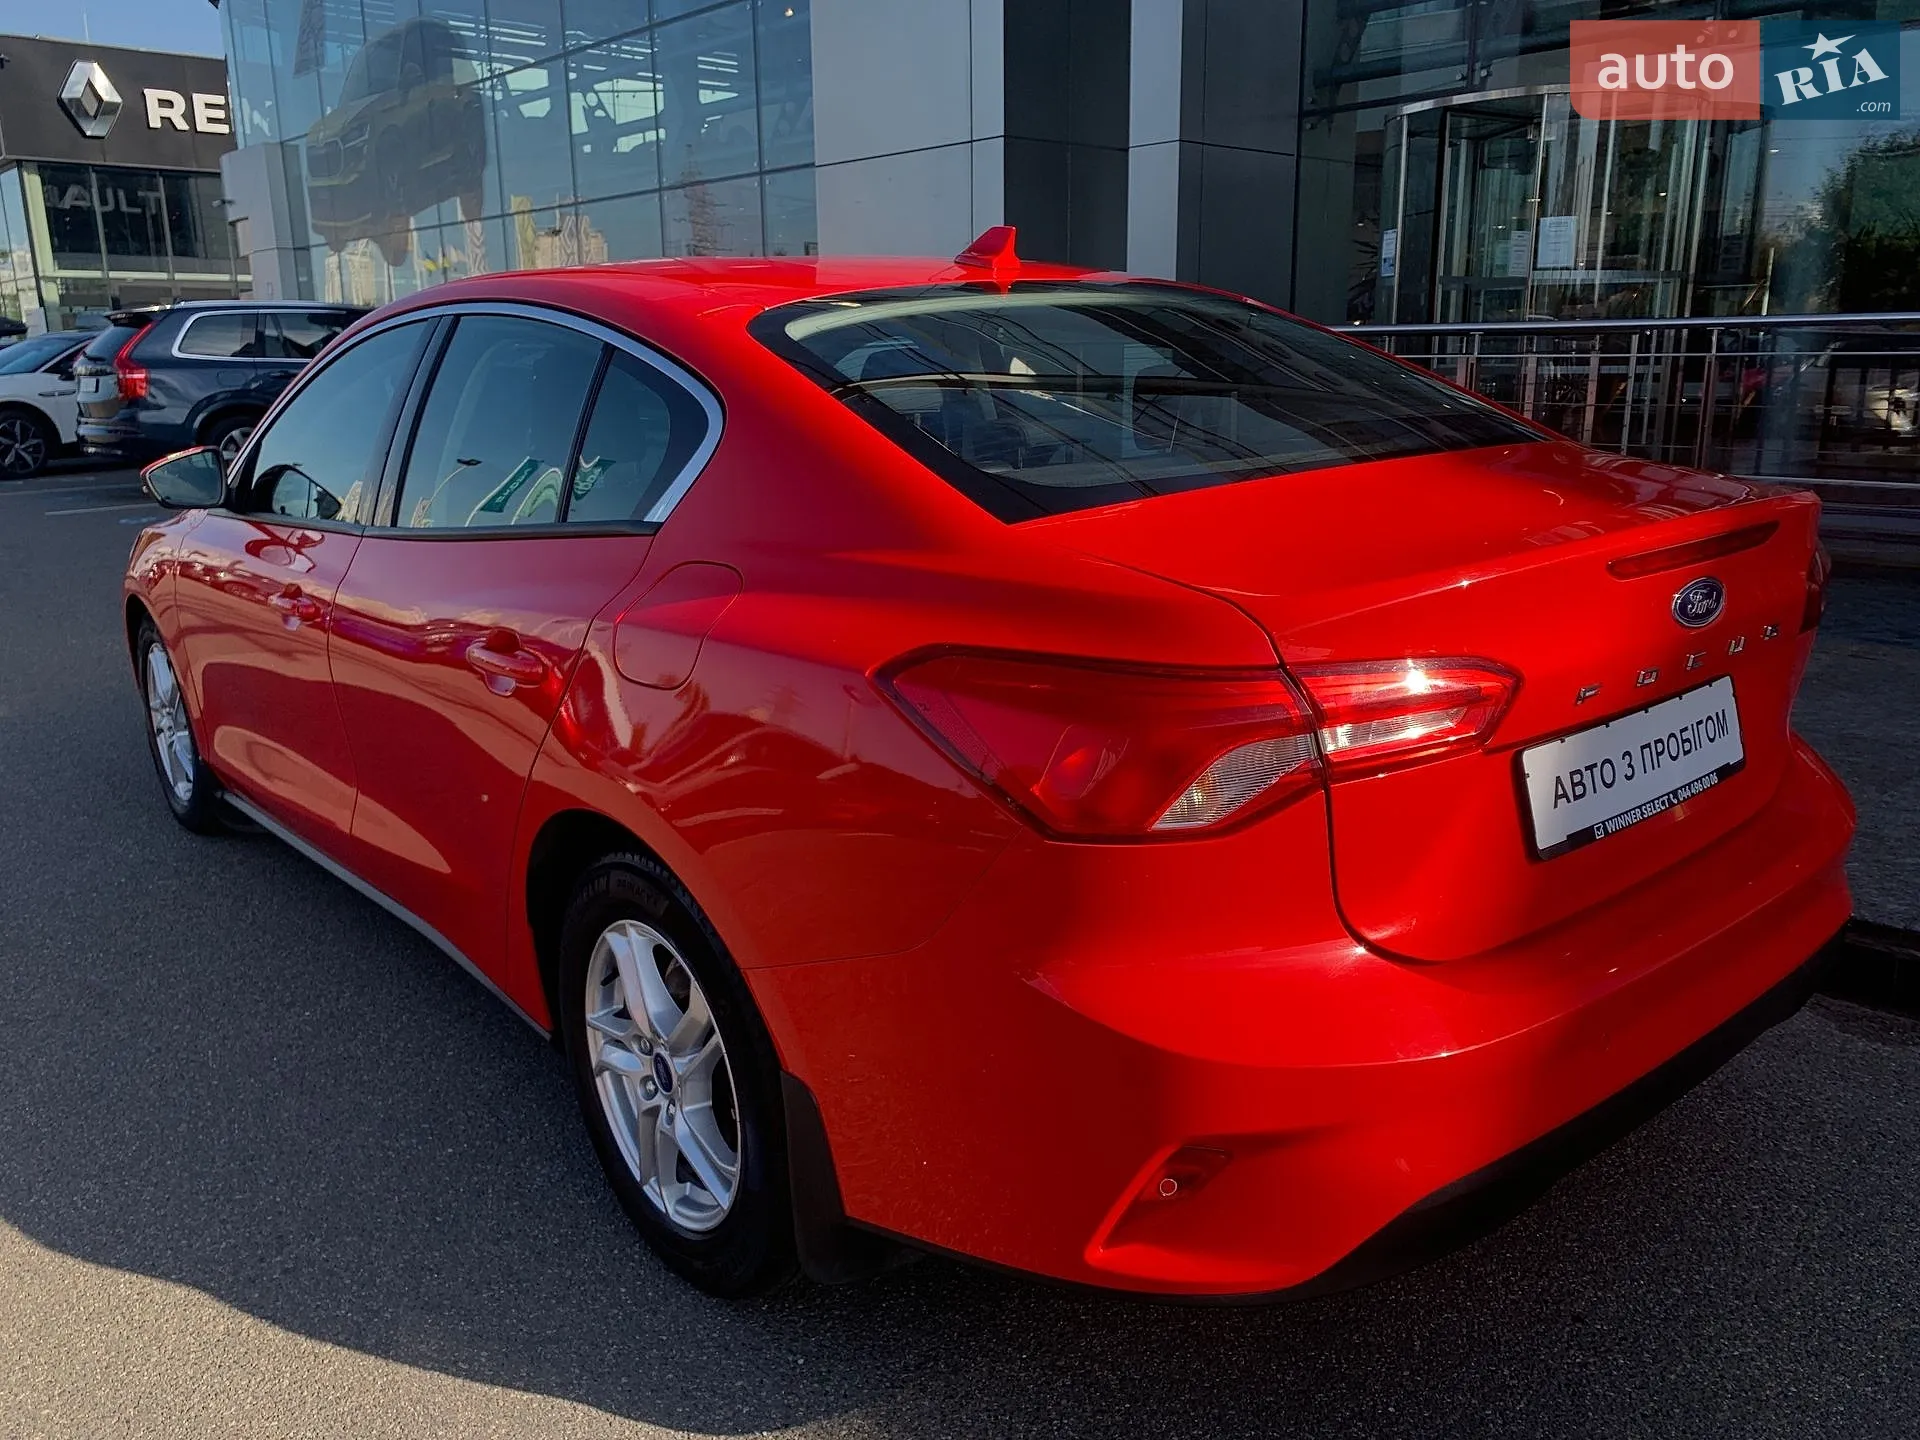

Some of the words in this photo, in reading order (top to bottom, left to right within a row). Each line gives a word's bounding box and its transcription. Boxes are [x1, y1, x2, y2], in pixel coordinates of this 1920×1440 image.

[1687, 588, 1717, 617] Ford
[1553, 758, 1617, 809] АВТО
[1639, 709, 1730, 775] ПРОБІГОМ
[1605, 810, 1643, 833] WINNER
[1642, 795, 1669, 817] SELECT
